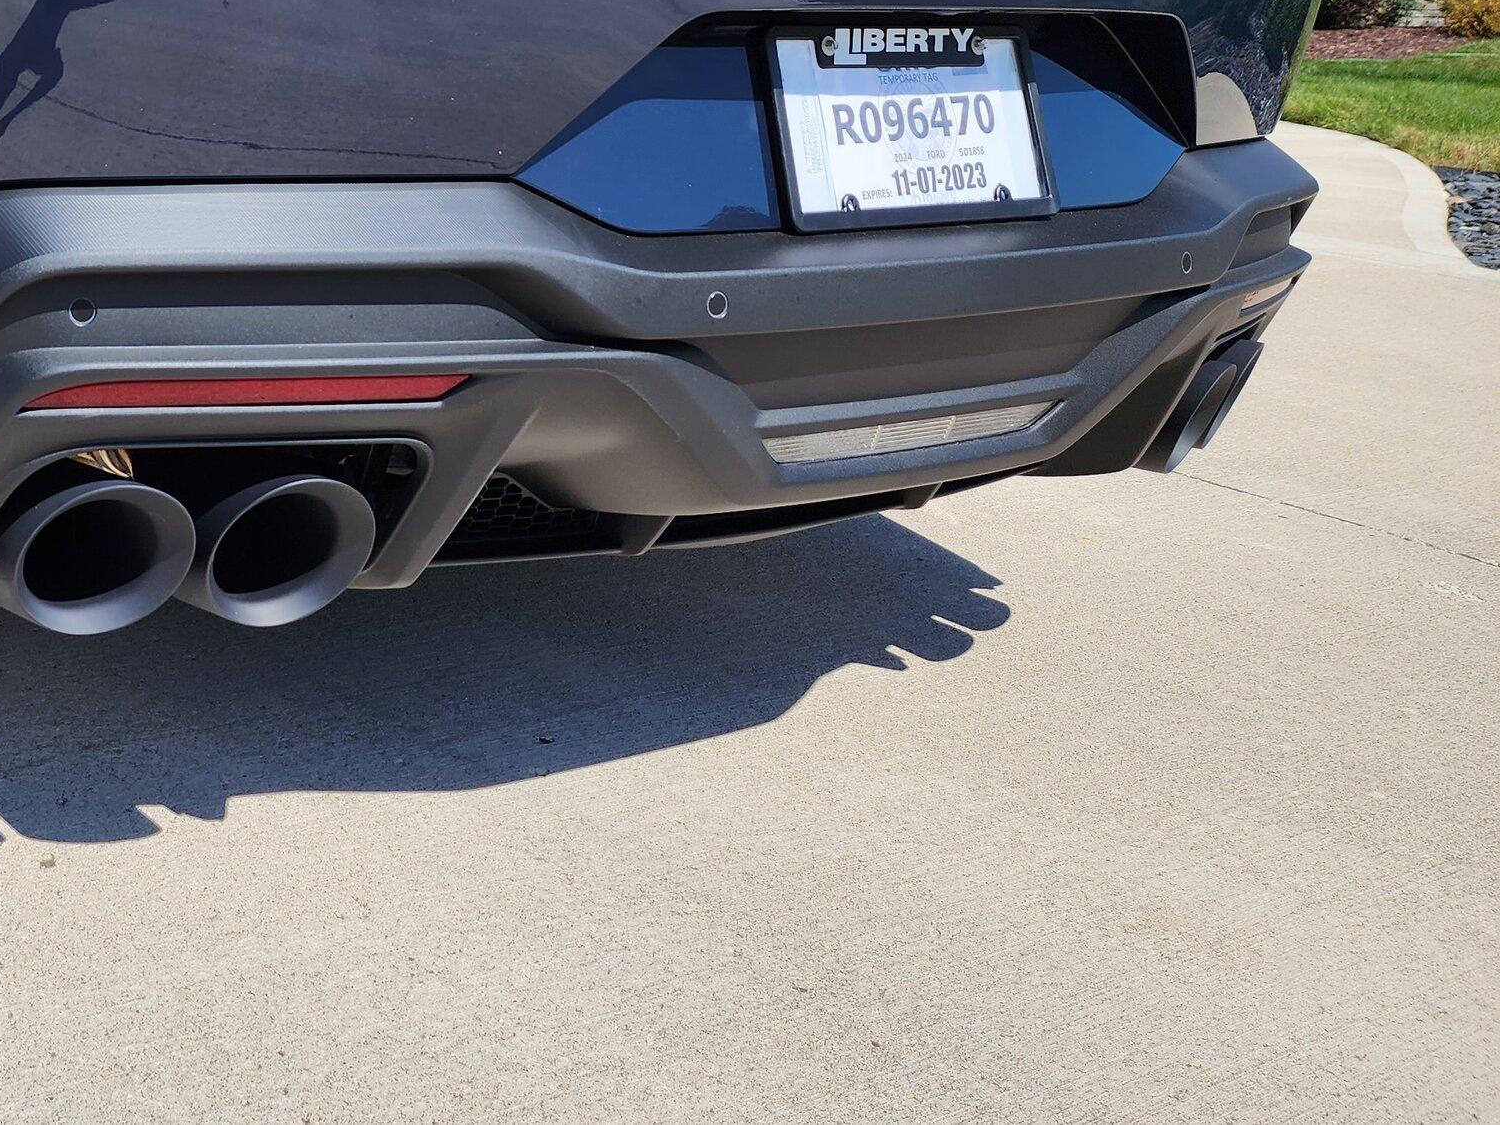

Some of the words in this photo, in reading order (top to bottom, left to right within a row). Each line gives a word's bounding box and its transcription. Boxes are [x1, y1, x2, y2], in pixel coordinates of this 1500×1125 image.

[833, 28, 974, 65] LIBERTY
[878, 74, 921, 85] TEMPORARY
[924, 72, 939, 82] TAG
[832, 93, 995, 146] R096470
[894, 152, 913, 163] 2024
[927, 149, 946, 160] FORD
[862, 189, 893, 200] EXPIRES:
[891, 161, 987, 196] 11-07-2023
